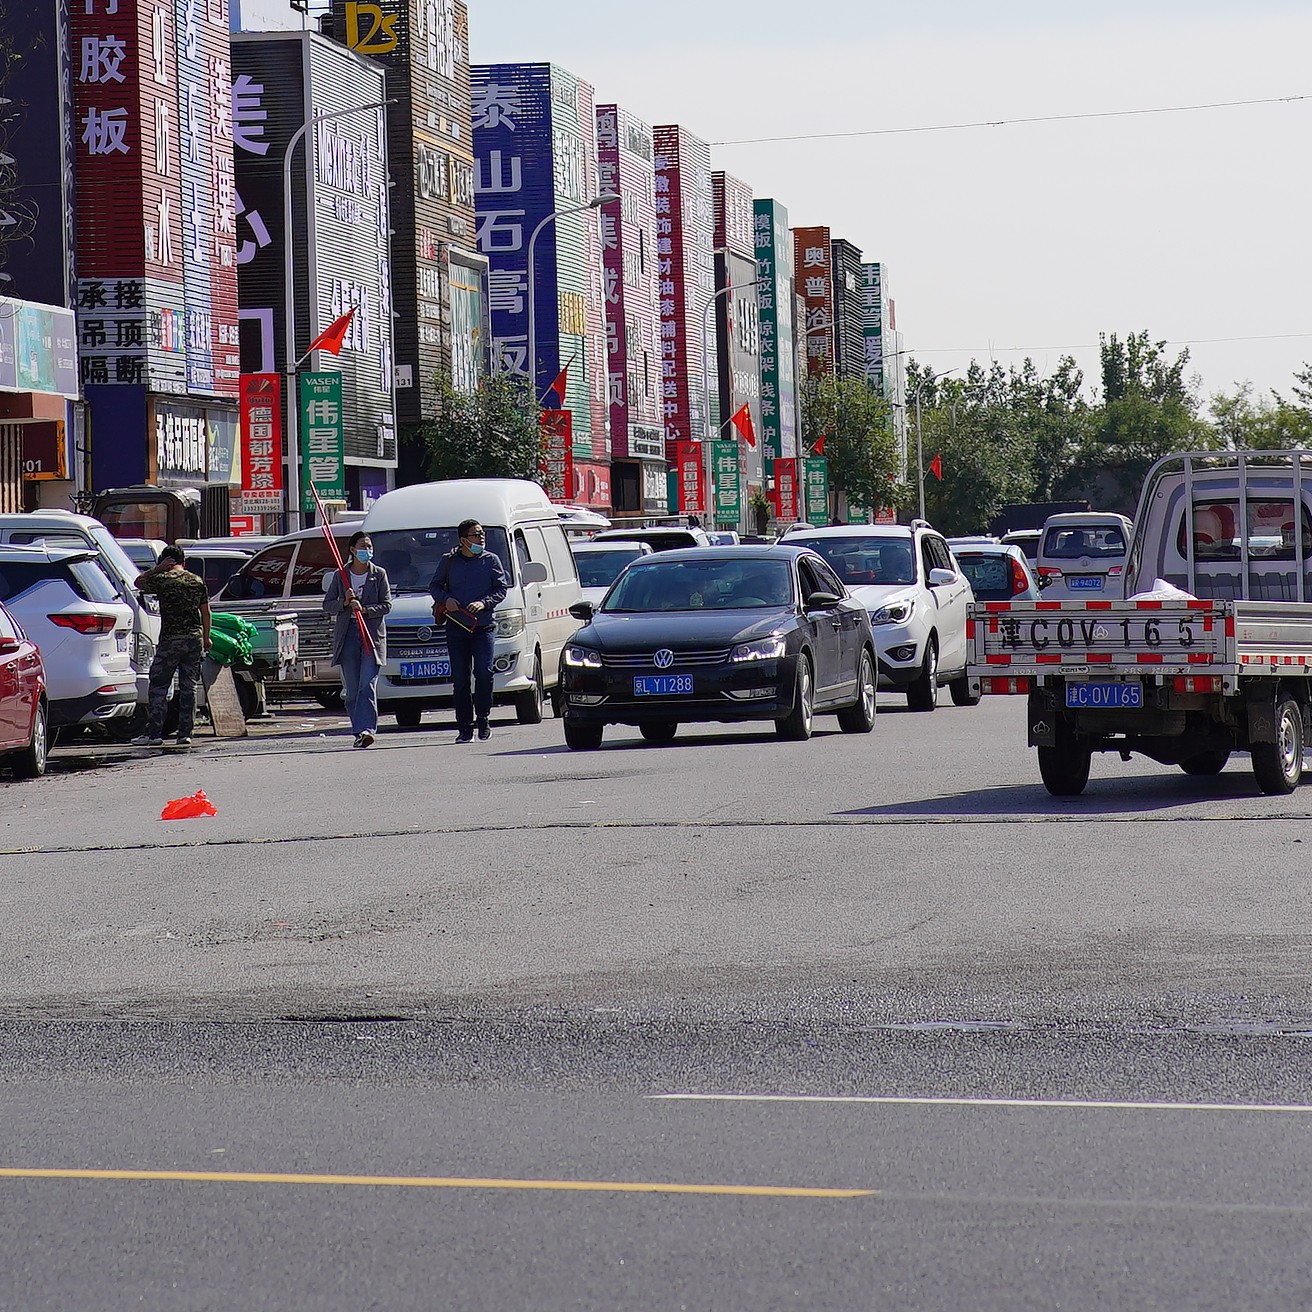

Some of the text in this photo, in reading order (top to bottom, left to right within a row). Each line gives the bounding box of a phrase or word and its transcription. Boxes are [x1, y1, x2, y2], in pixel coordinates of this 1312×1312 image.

[79, 280, 144, 309] 承接
[82, 319, 144, 348] 吊顶
[82, 355, 144, 385] 隔断
[305, 378, 339, 386] VASEN
[248, 407, 274, 489] 德国都芳漆
[306, 399, 340, 483] 伟星管
[716, 456, 738, 506] 伟星管
[808, 470, 825, 513] 伟星管
